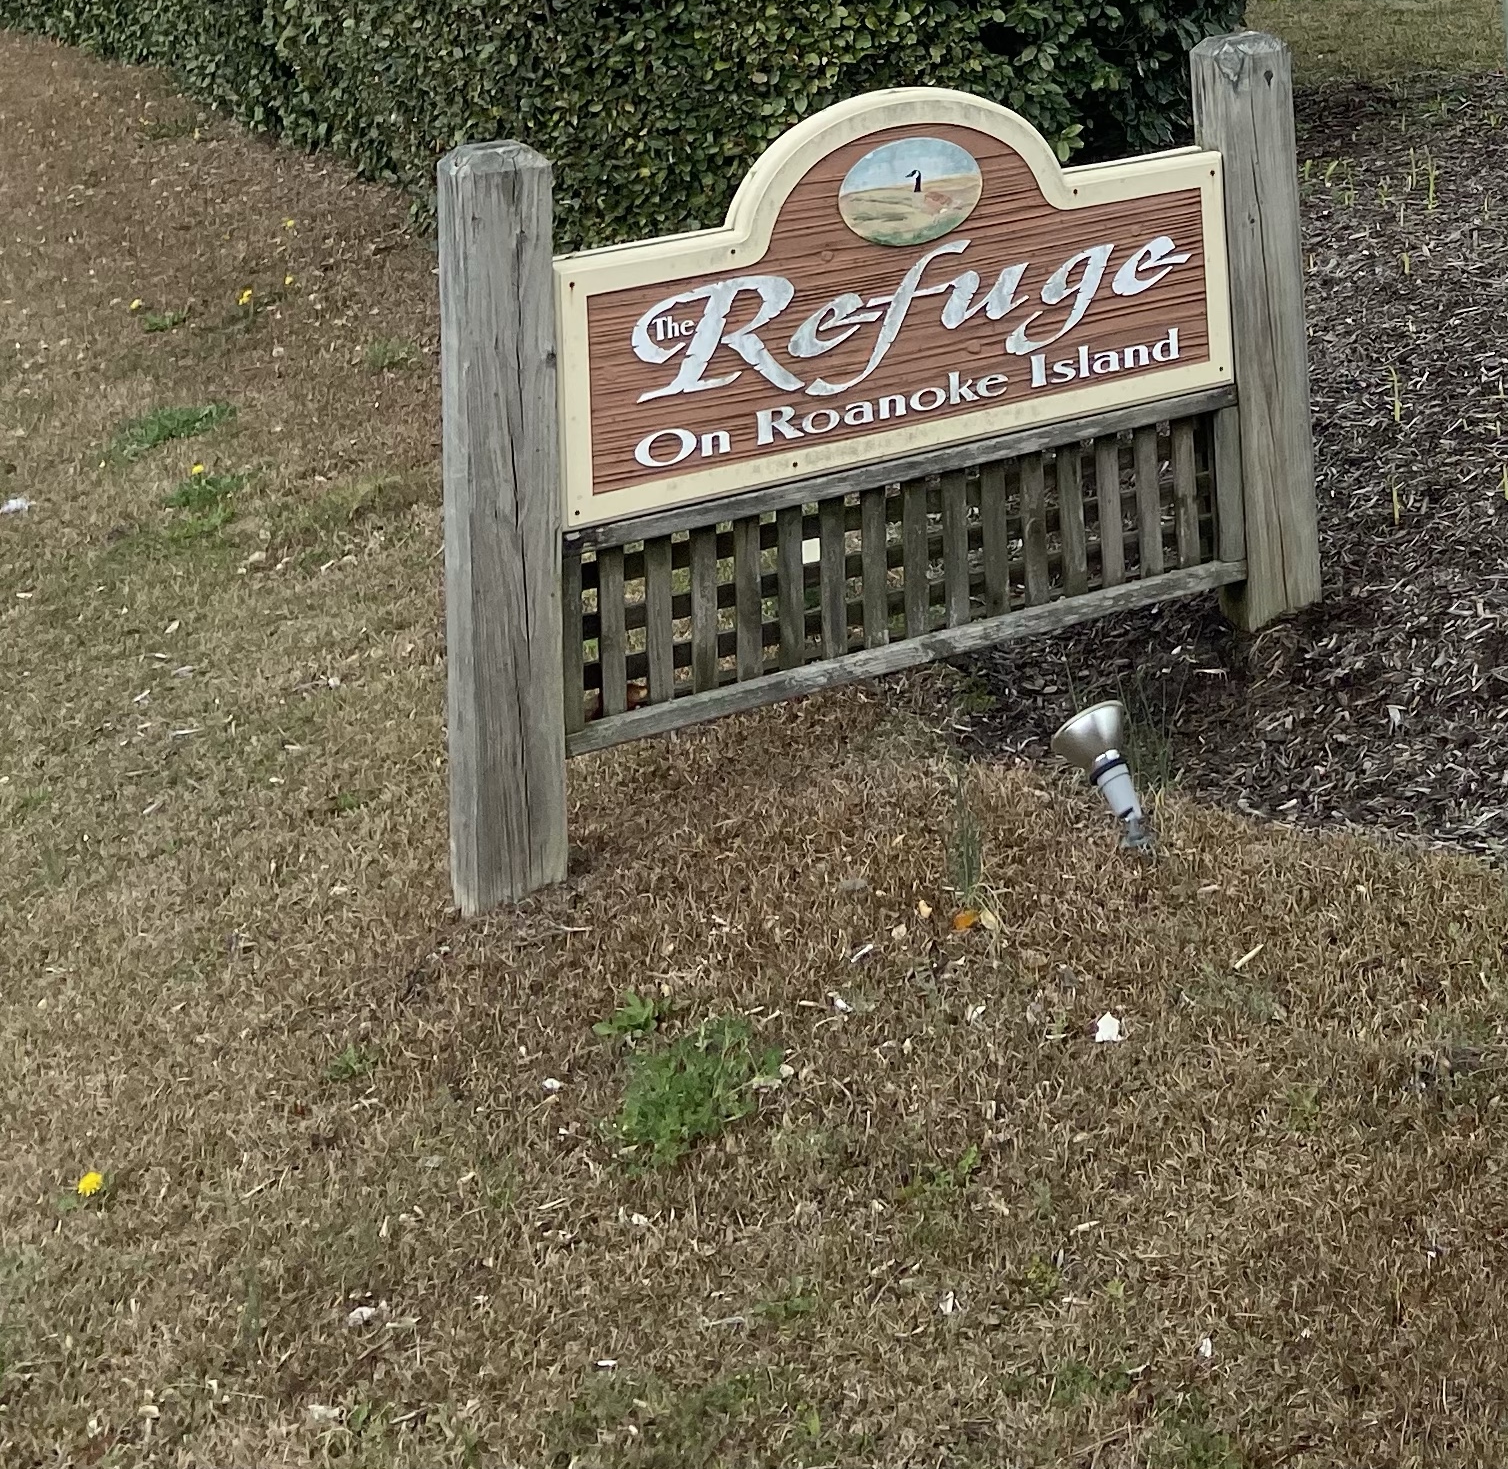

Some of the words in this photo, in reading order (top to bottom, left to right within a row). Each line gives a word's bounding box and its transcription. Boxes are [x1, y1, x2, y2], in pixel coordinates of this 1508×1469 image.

[631, 236, 1192, 403] Refuge
[653, 315, 694, 340] The
[634, 427, 731, 467] On
[756, 371, 1008, 446] Roanoke
[1030, 328, 1181, 388] Island
